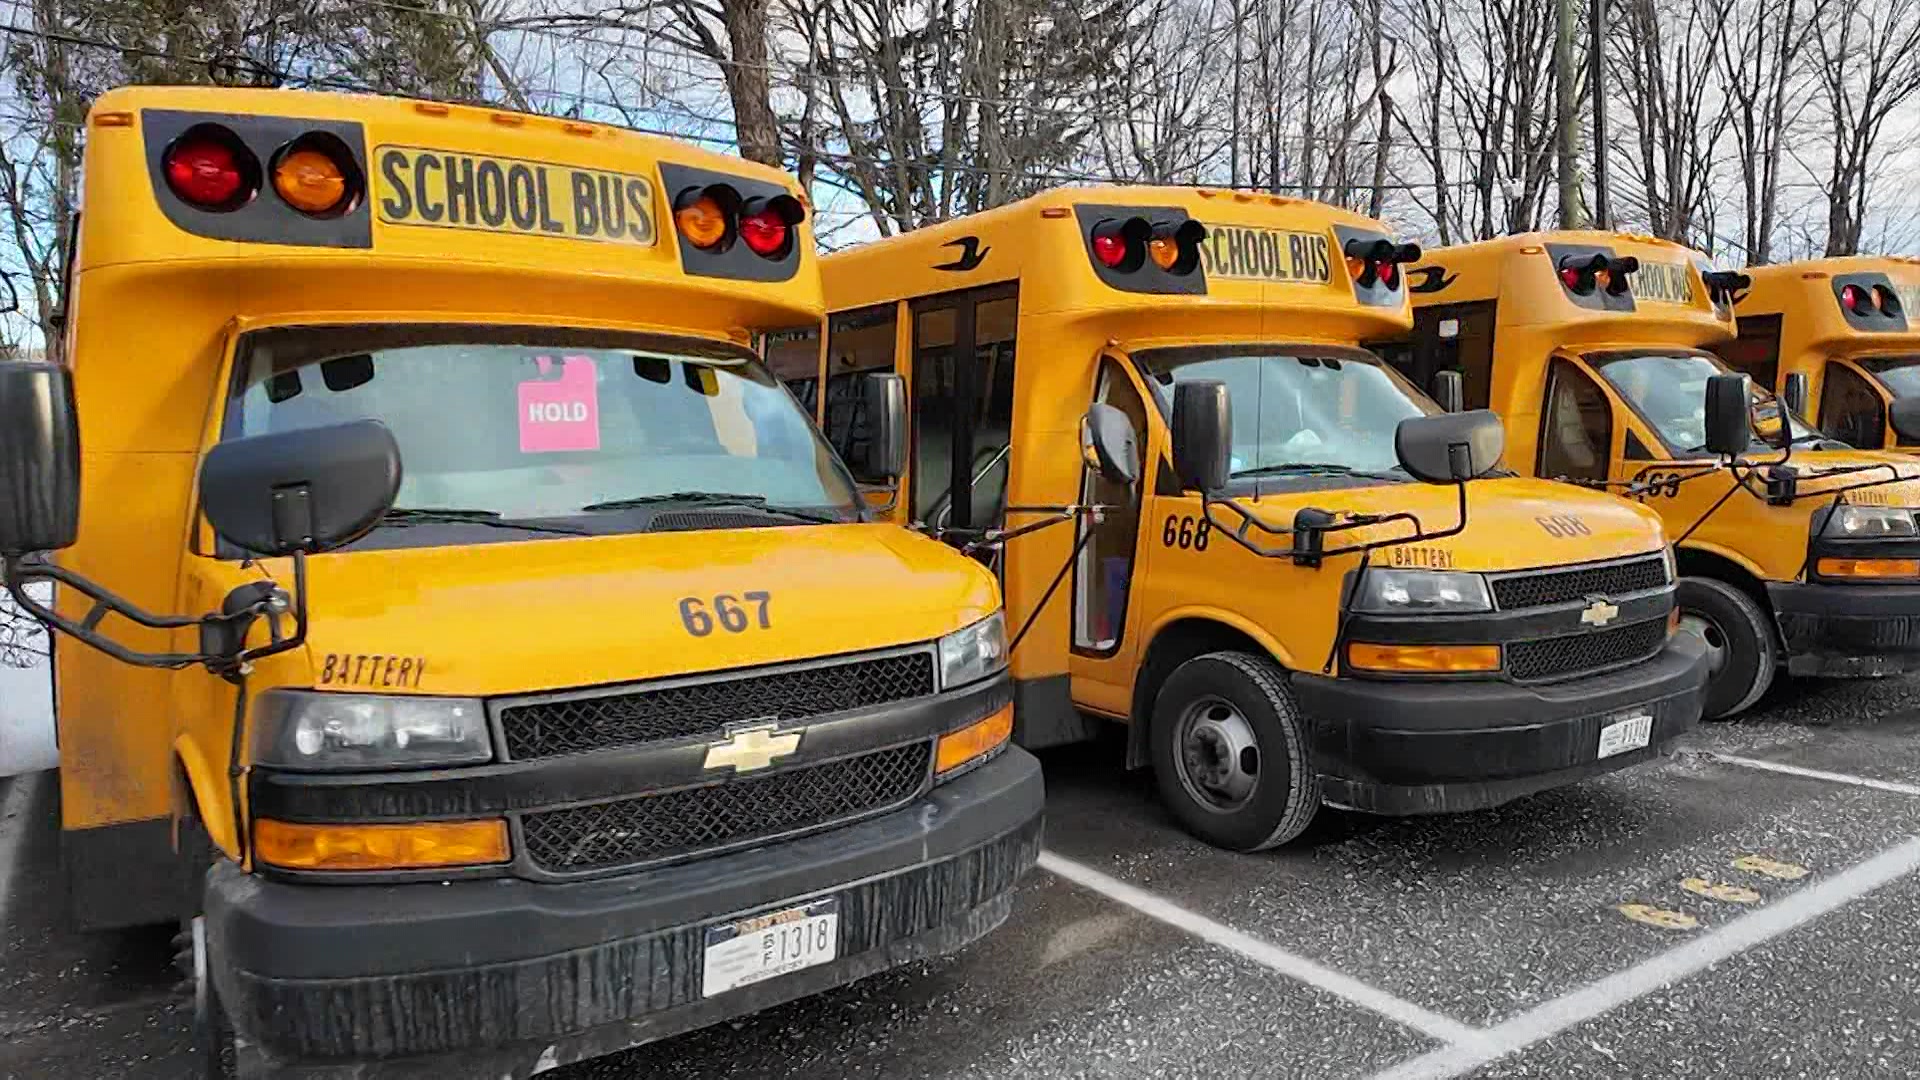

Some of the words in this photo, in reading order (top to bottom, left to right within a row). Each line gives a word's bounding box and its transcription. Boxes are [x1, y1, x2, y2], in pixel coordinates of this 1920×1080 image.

[380, 149, 565, 234] SCHOOL
[571, 171, 653, 243] BUS
[1288, 233, 1330, 283] BUS
[528, 401, 588, 423] HOLD
[1163, 513, 1210, 552] 668
[1394, 546, 1454, 568] BATTERY
[678, 590, 773, 638] 667
[321, 653, 426, 688] BATTERY
[780, 918, 830, 962] 1318
